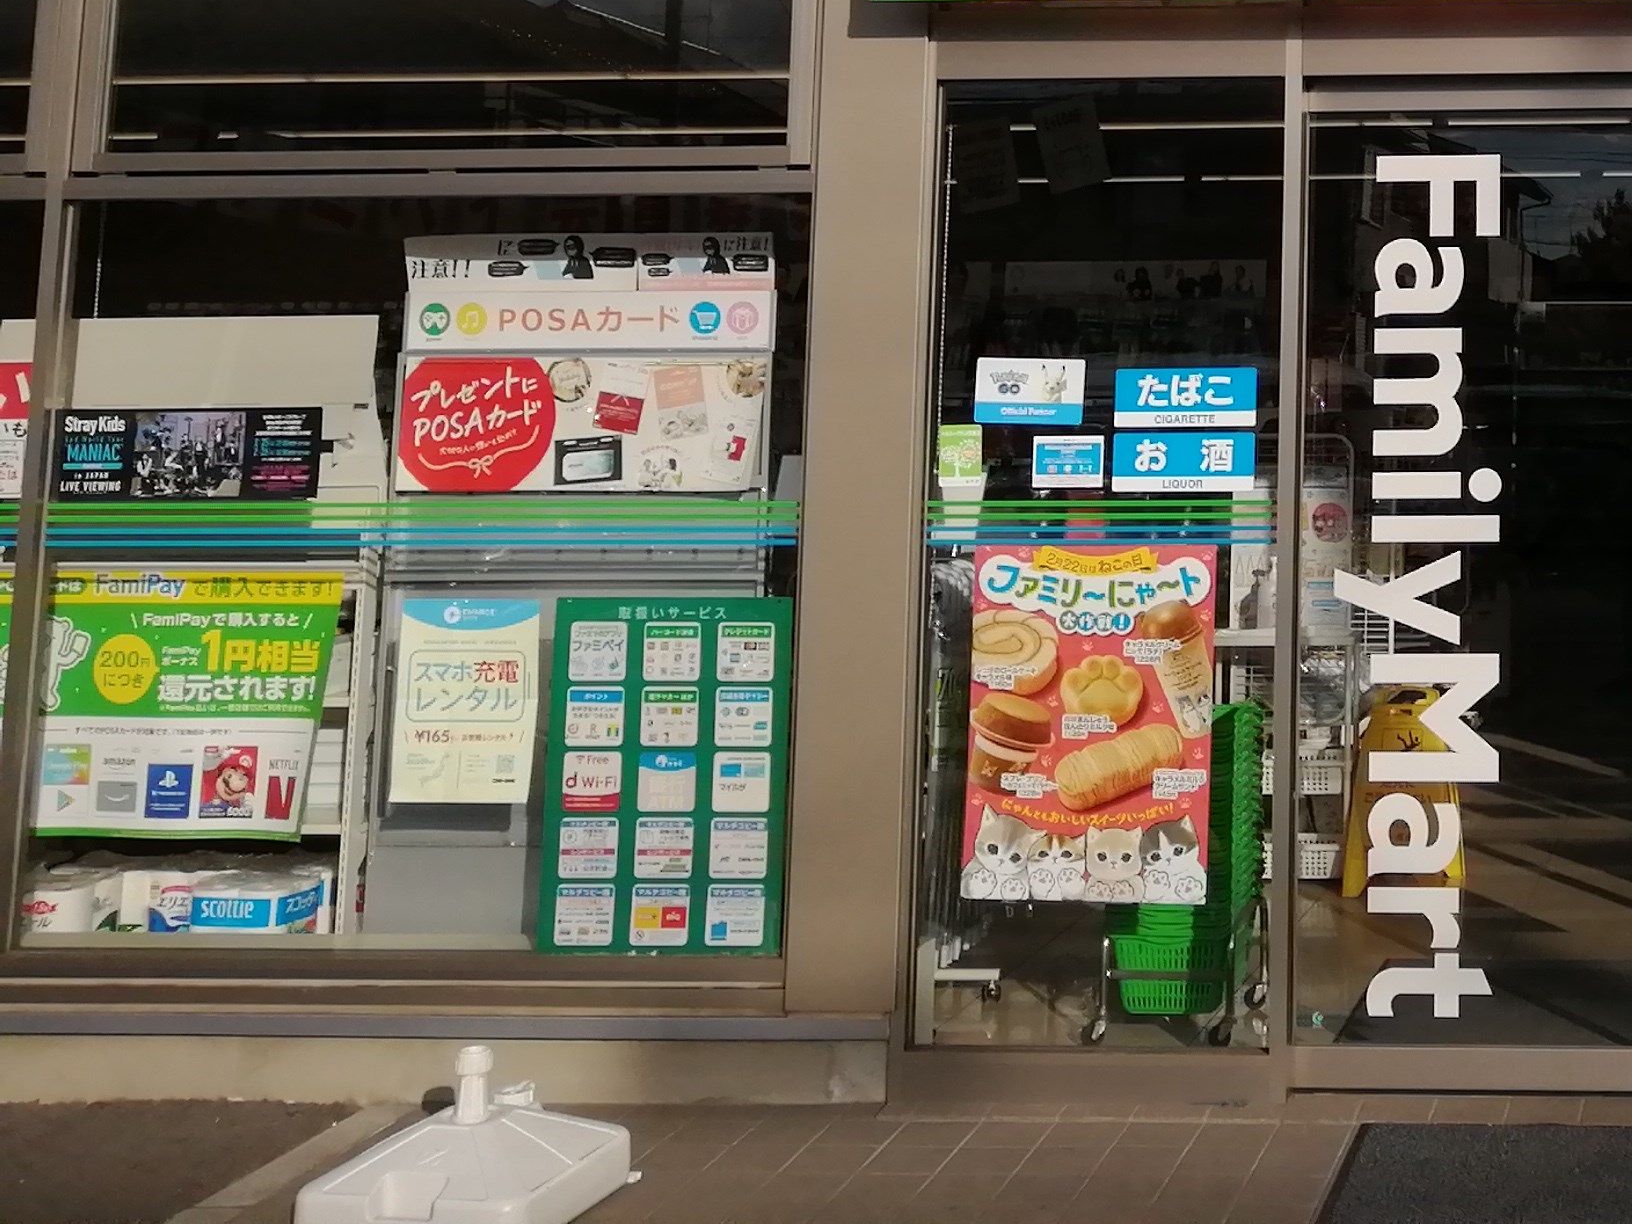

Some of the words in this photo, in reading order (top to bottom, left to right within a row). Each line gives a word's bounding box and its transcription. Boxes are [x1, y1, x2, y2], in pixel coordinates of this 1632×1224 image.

[498, 305, 680, 333] POSAカード
[411, 367, 539, 412] プレゼントに
[998, 383, 1021, 394] GO
[1137, 373, 1234, 407] たばこ
[65, 416, 97, 436] Stray
[98, 416, 126, 433] Kids
[414, 399, 543, 446] POSAカード
[1154, 414, 1216, 424] CIGARETTE
[60, 481, 80, 493] LIVE
[82, 480, 121, 493] VIEWING
[1162, 479, 1204, 489] LIQUOR
[95, 574, 186, 597] FamiPay
[1333, 154, 1502, 1019] FamilyMart
[201, 630, 321, 674] 1円相当
[572, 639, 625, 652] ファミペイ
[103, 673, 144, 689] につき
[415, 660, 519, 683] スマホ充電
[157, 675, 316, 702] 還元されます!
[416, 687, 517, 712] レンタル
[104, 758, 136, 767] amazon
[587, 755, 610, 765] Free
[582, 776, 617, 788] Wi-Fi
